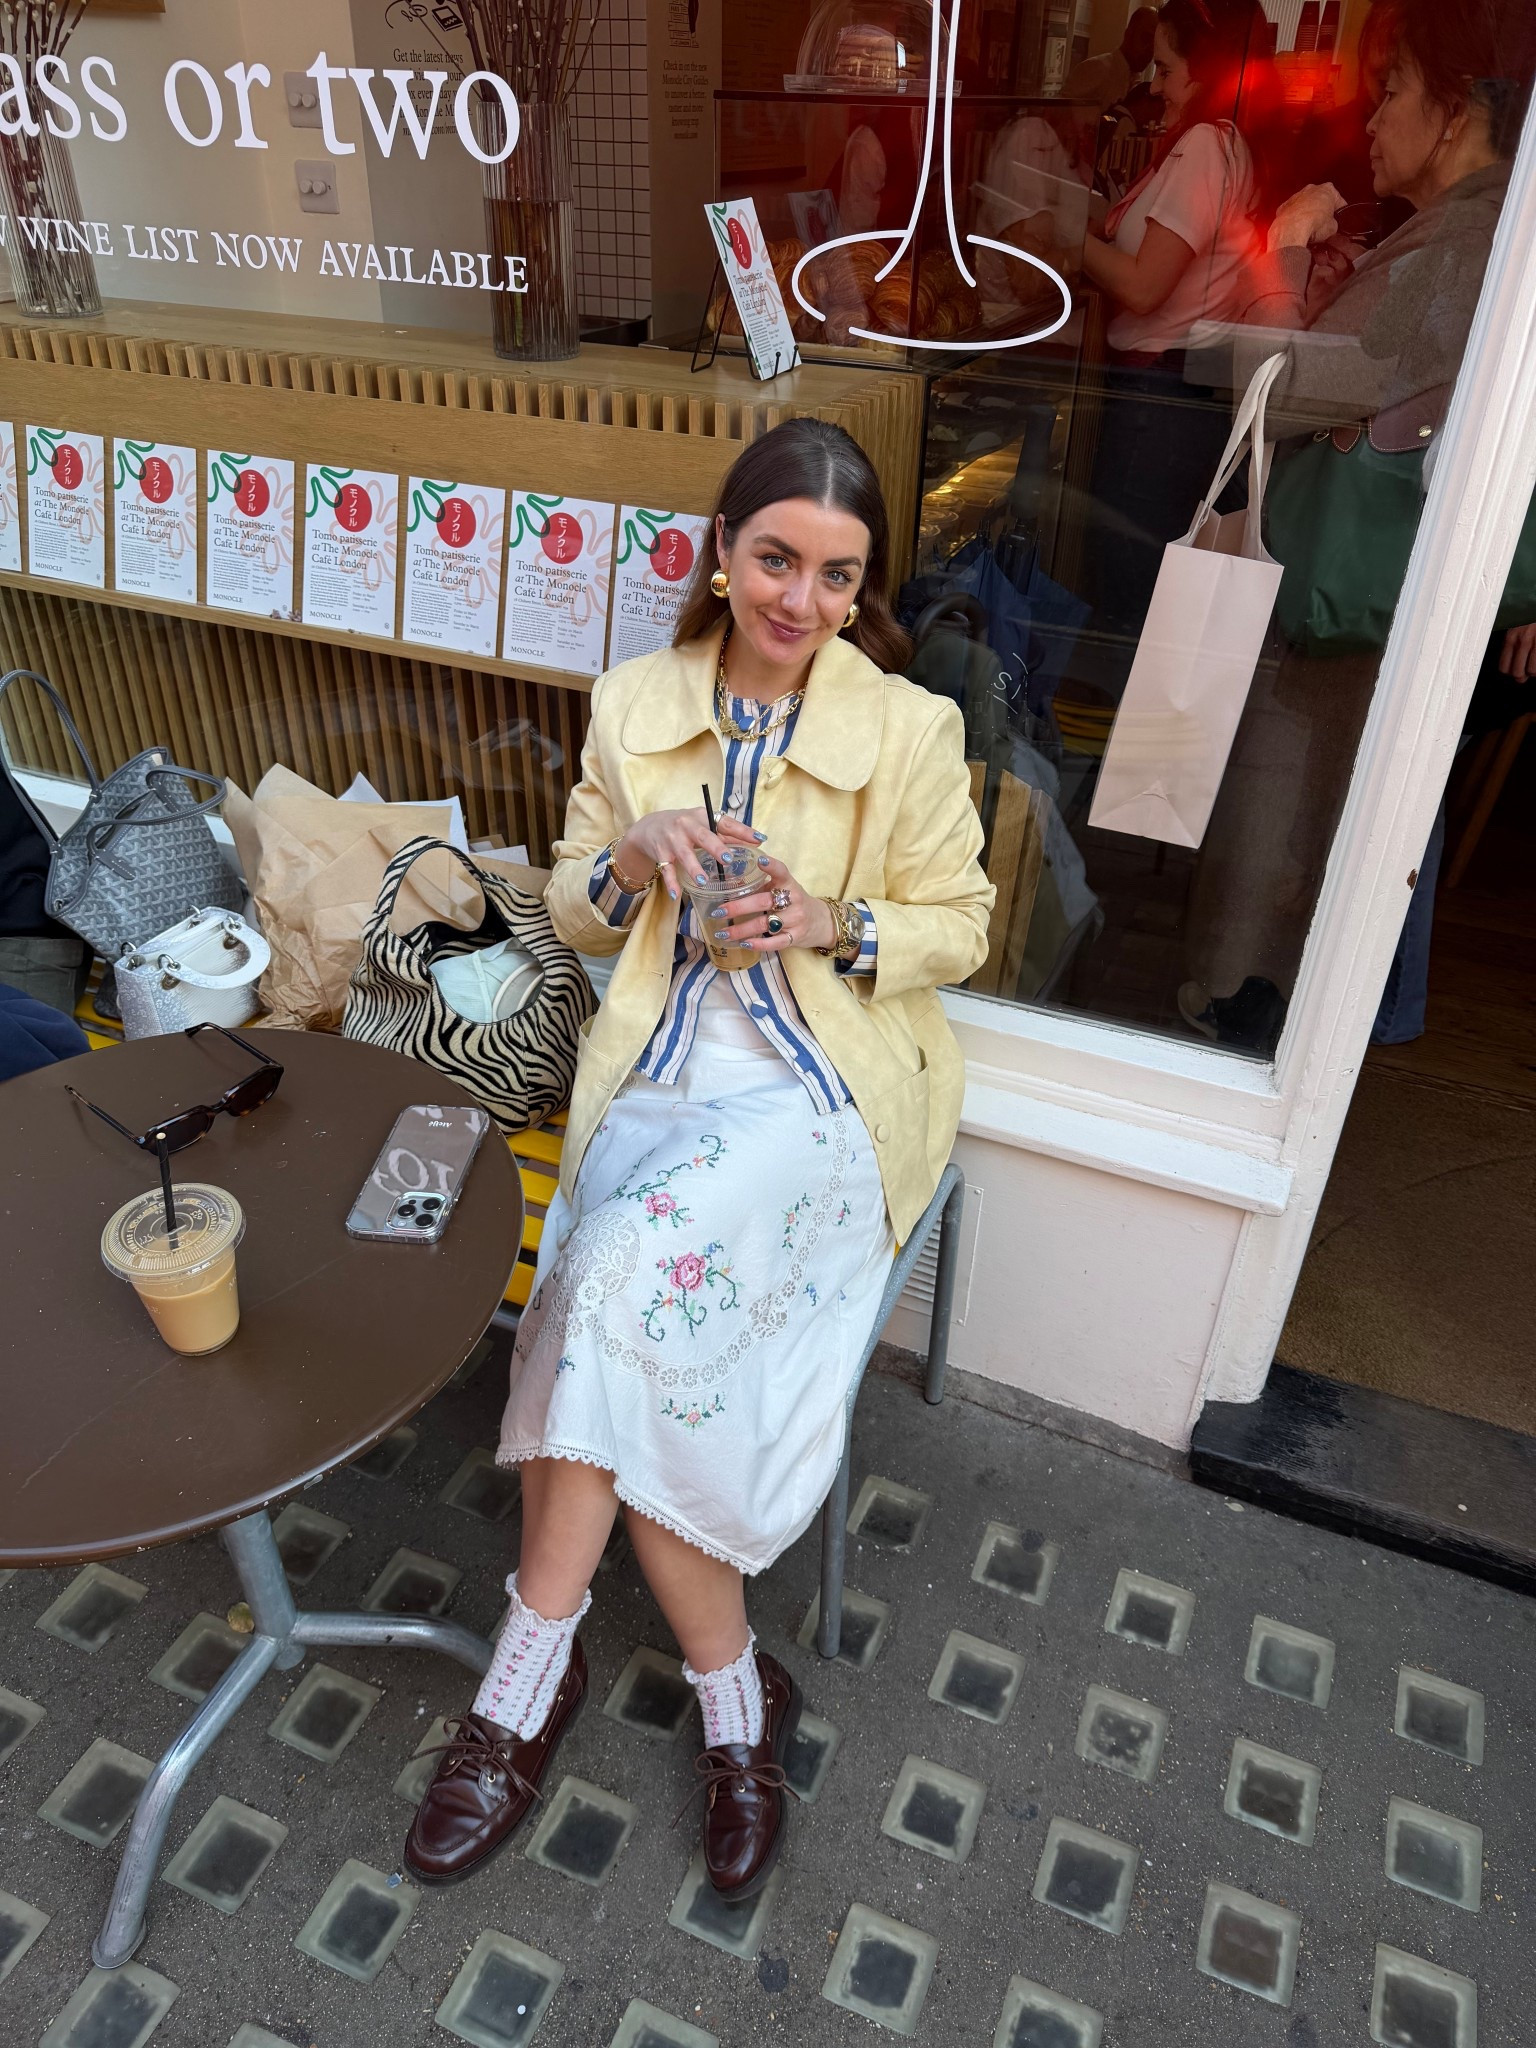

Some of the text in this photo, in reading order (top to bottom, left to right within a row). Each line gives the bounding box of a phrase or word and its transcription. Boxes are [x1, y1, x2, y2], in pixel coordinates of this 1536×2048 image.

[394, 48, 463, 63] Get the latest news
[0, 51, 520, 164] ass or two
[17, 216, 114, 256] WINE
[122, 224, 199, 264] LIST
[210, 232, 303, 273] NOW
[319, 240, 529, 293] AVAILABLE
[152, 462, 161, 498] モノクル
[34, 486, 89, 504] Tomo patisserie
[248, 474, 256, 512] モノクル
[43, 499, 57, 510] The
[59, 502, 89, 515] Monocle
[121, 500, 180, 518] Tomo patisserie
[349, 488, 357, 527] モノクル
[34, 509, 52, 520] Café
[54, 514, 81, 525] London
[130, 514, 145, 524] The
[148, 516, 180, 529] Monocle
[214, 514, 275, 532] Tomo patisserie
[452, 502, 461, 542] モノクル
[121, 524, 171, 539] Café London
[222, 527, 239, 538] The
[242, 530, 275, 544] Monocle
[312, 529, 377, 547] Tomo patisserie
[557, 517, 567, 558] モノクル
[214, 538, 232, 548] Café
[235, 541, 266, 554] London
[321, 543, 339, 554] The
[342, 546, 377, 559] Monocle
[414, 544, 480, 563] Tomo patisserie
[666, 533, 678, 576] モノクル
[312, 553, 367, 570] Café London
[422, 558, 440, 569] The
[443, 562, 480, 576] Monocle
[516, 560, 587, 581] Tomo patisserie
[413, 569, 469, 586] Café London
[515, 574, 586, 593] at The Monocle
[623, 577, 651, 590] Tomo
[514, 586, 574, 604] Café London
[632, 592, 652, 604] The
[310, 611, 342, 621] MONOCLE
[621, 604, 643, 615] Café
[410, 628, 442, 638] MONOCLE
[511, 646, 545, 657] MONOCLE
